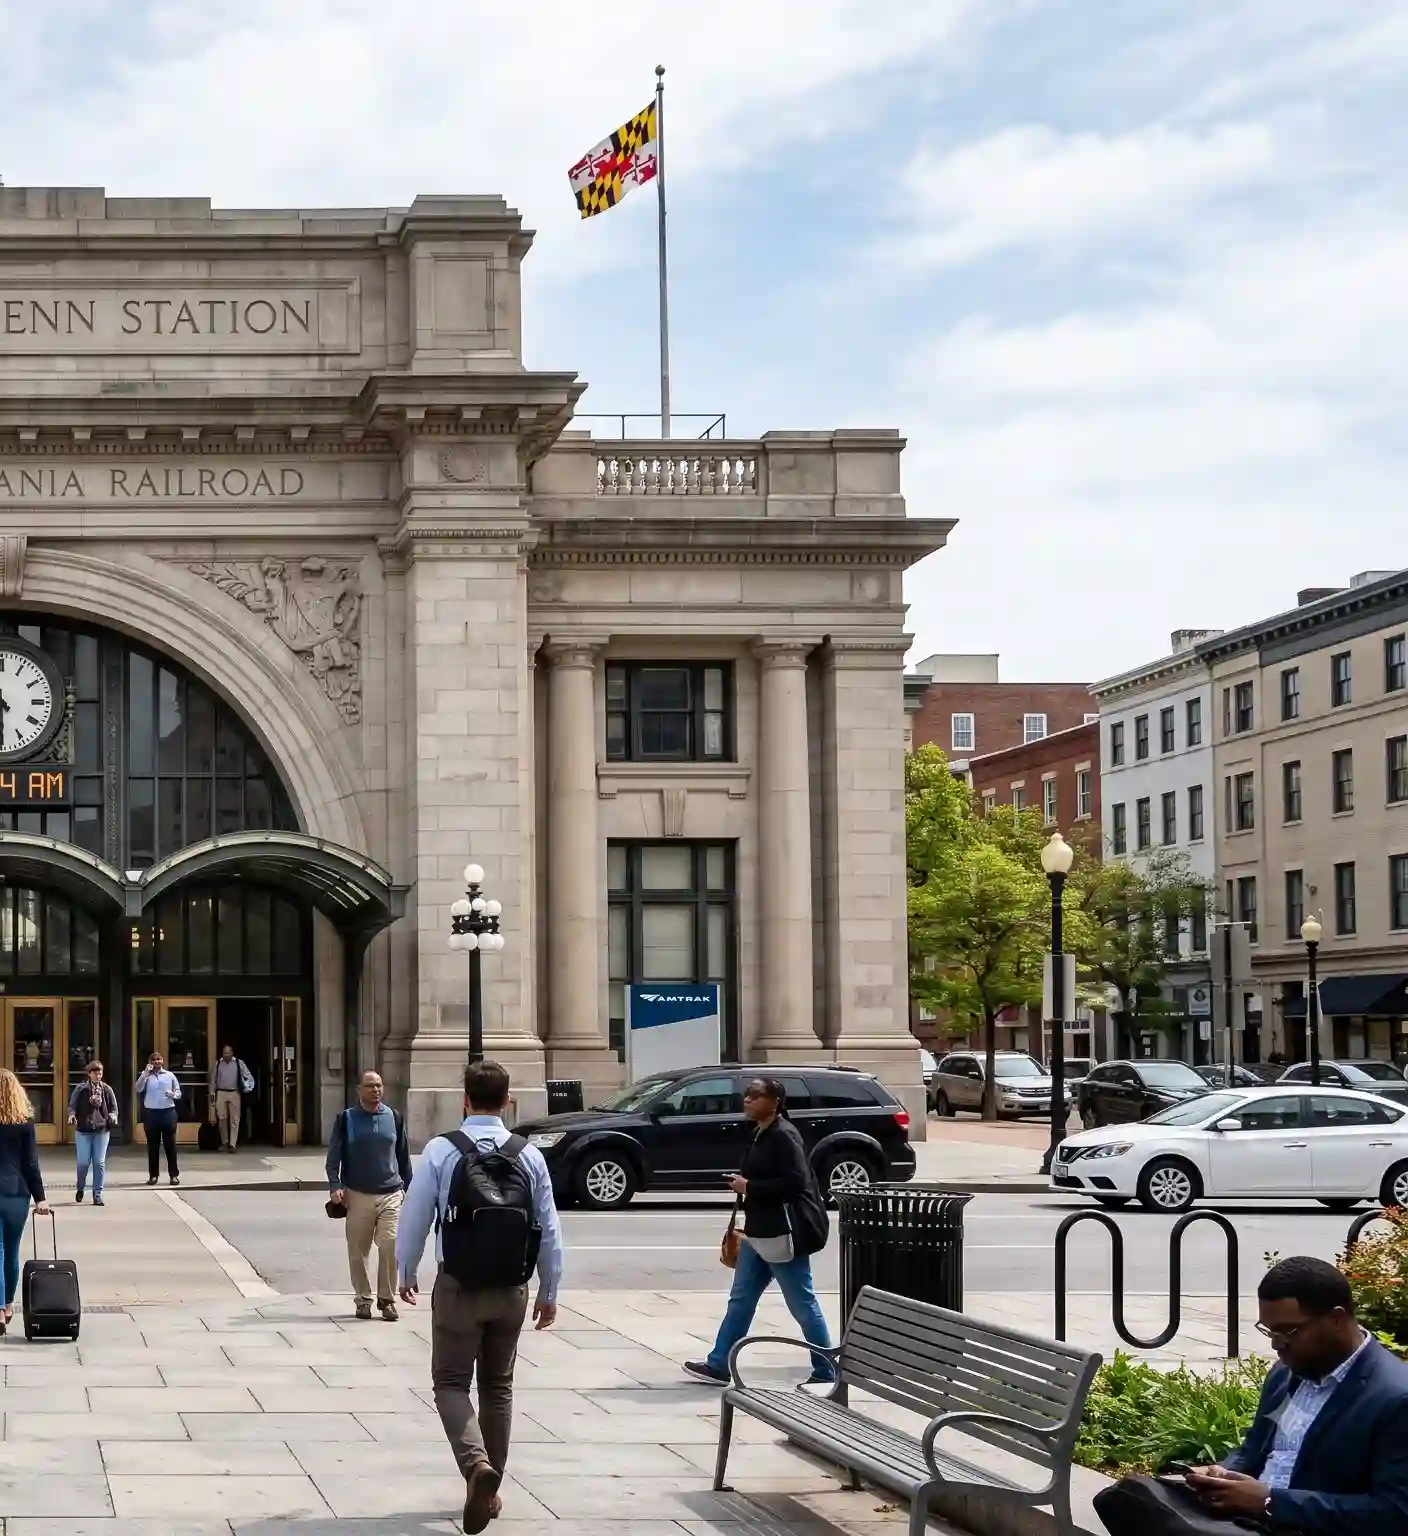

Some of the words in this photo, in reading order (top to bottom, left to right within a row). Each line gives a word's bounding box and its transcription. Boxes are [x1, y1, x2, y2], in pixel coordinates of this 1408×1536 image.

[121, 299, 312, 335] STATION
[109, 468, 305, 497] RAILROAD
[28, 772, 63, 799] AM
